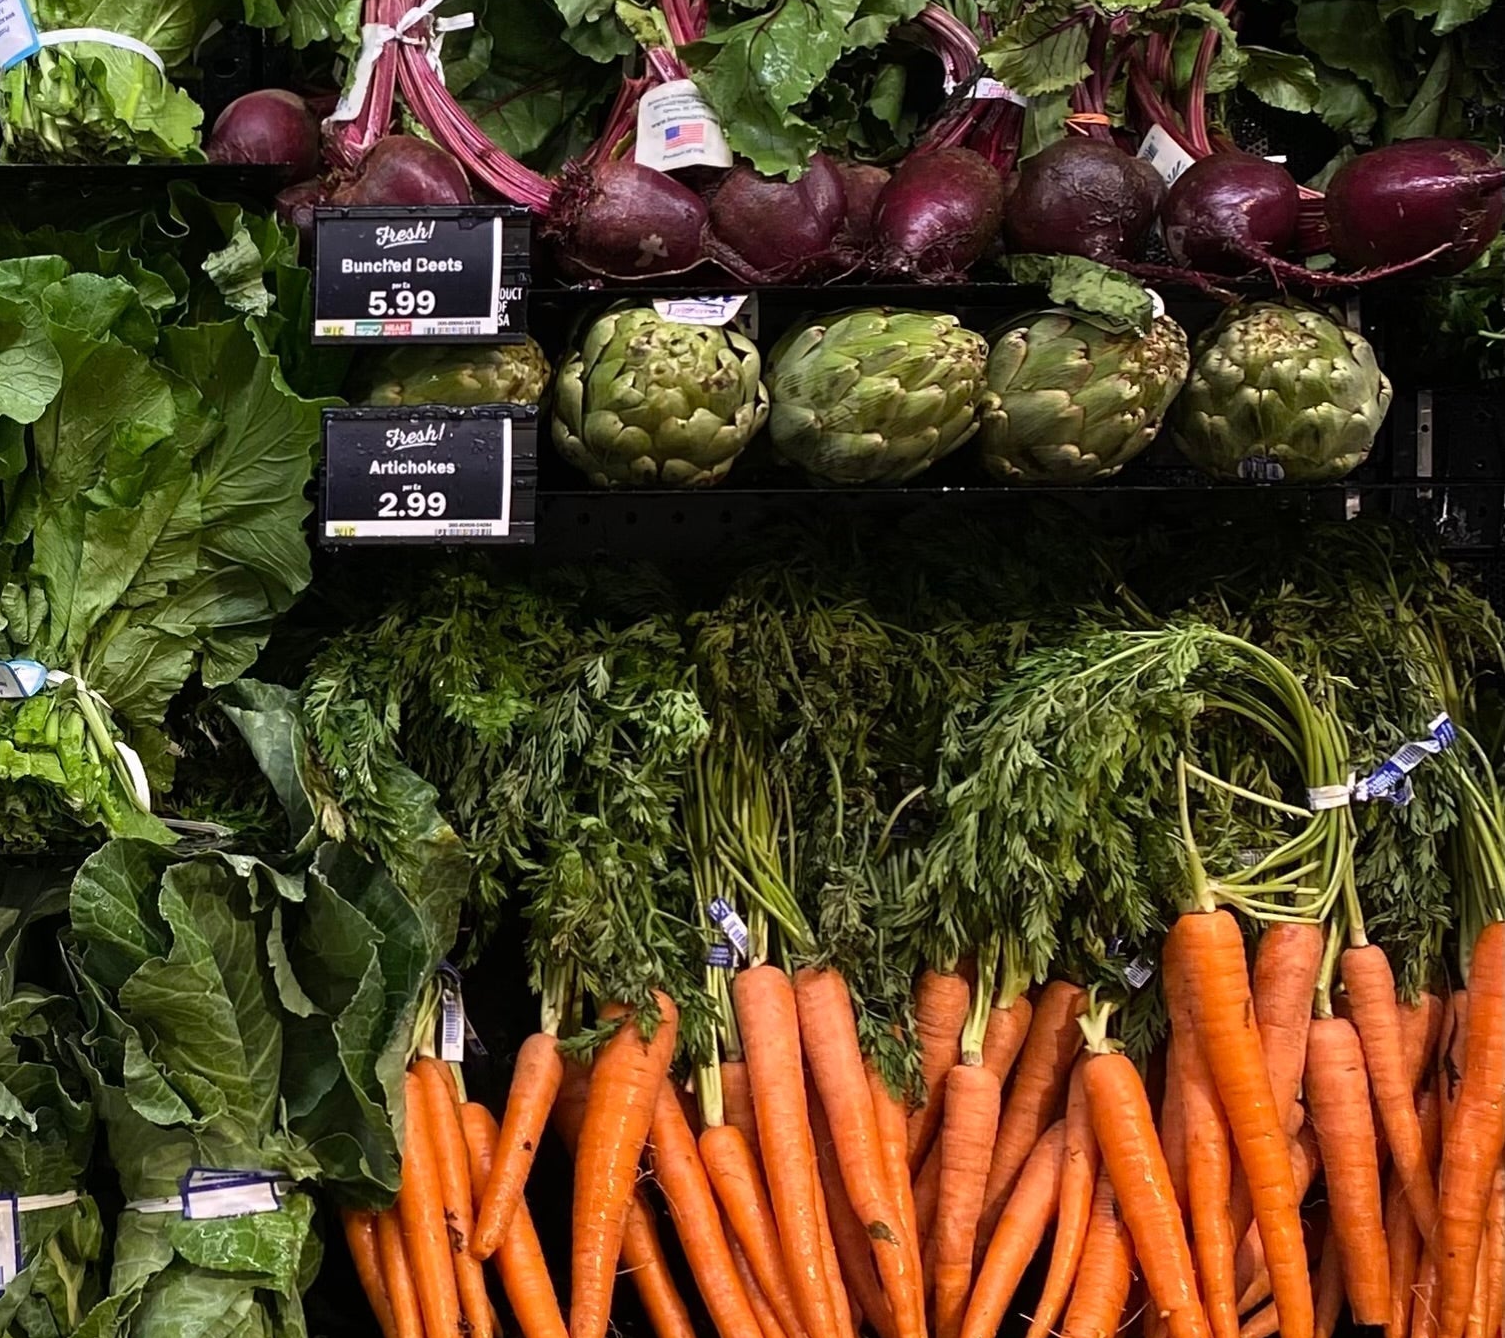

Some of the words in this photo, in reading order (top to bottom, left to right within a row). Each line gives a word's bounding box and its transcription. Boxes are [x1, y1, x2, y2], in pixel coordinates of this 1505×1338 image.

[375, 220, 435, 246] Fresh!
[341, 258, 412, 273] Bunched
[368, 290, 436, 315] 5.99
[499, 287, 523, 300] DUCT
[497, 313, 510, 327] SA
[386, 423, 446, 447] Fresh!
[369, 460, 455, 475] Artichokes
[378, 492, 446, 517] 2.99
